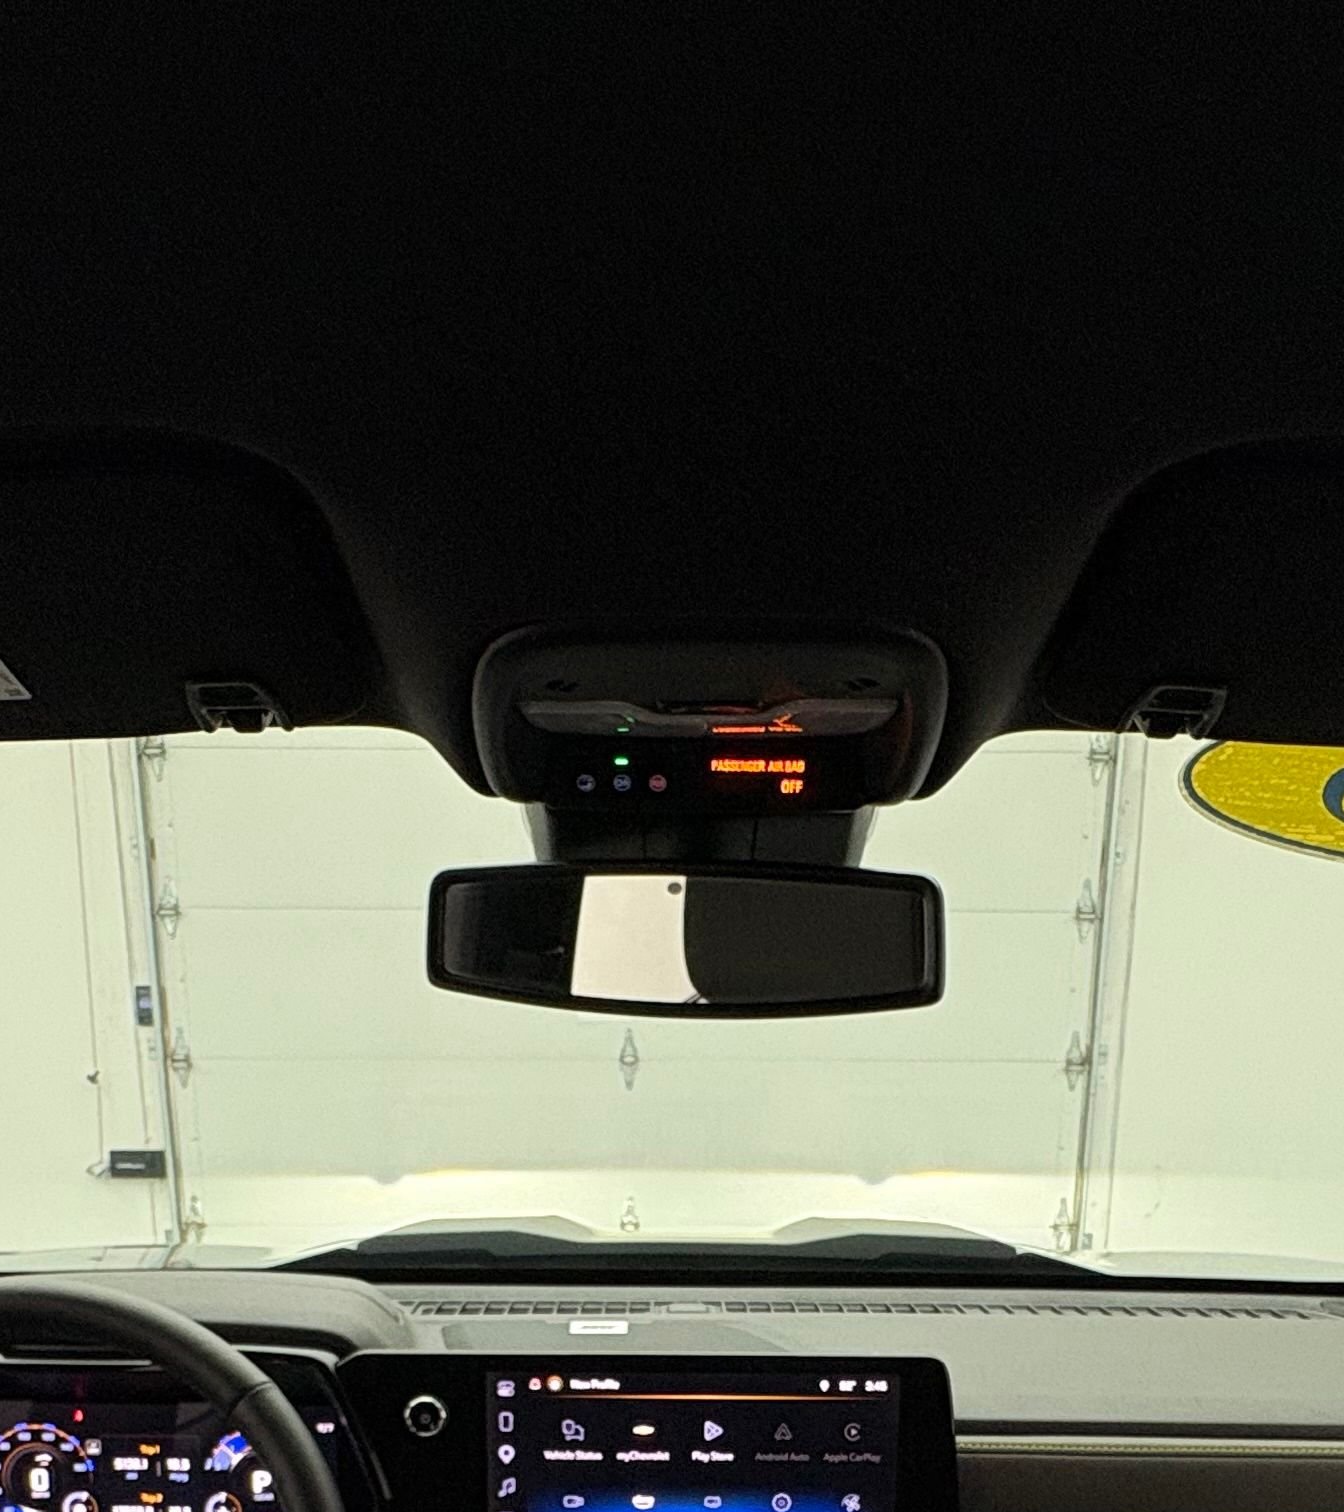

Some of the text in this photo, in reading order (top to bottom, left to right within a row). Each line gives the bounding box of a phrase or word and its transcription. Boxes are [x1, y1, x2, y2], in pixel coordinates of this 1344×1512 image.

[711, 759, 805, 773] PASSENGER AIR BAG
[780, 779, 803, 793] OFF
[252, 1470, 272, 1494] P
